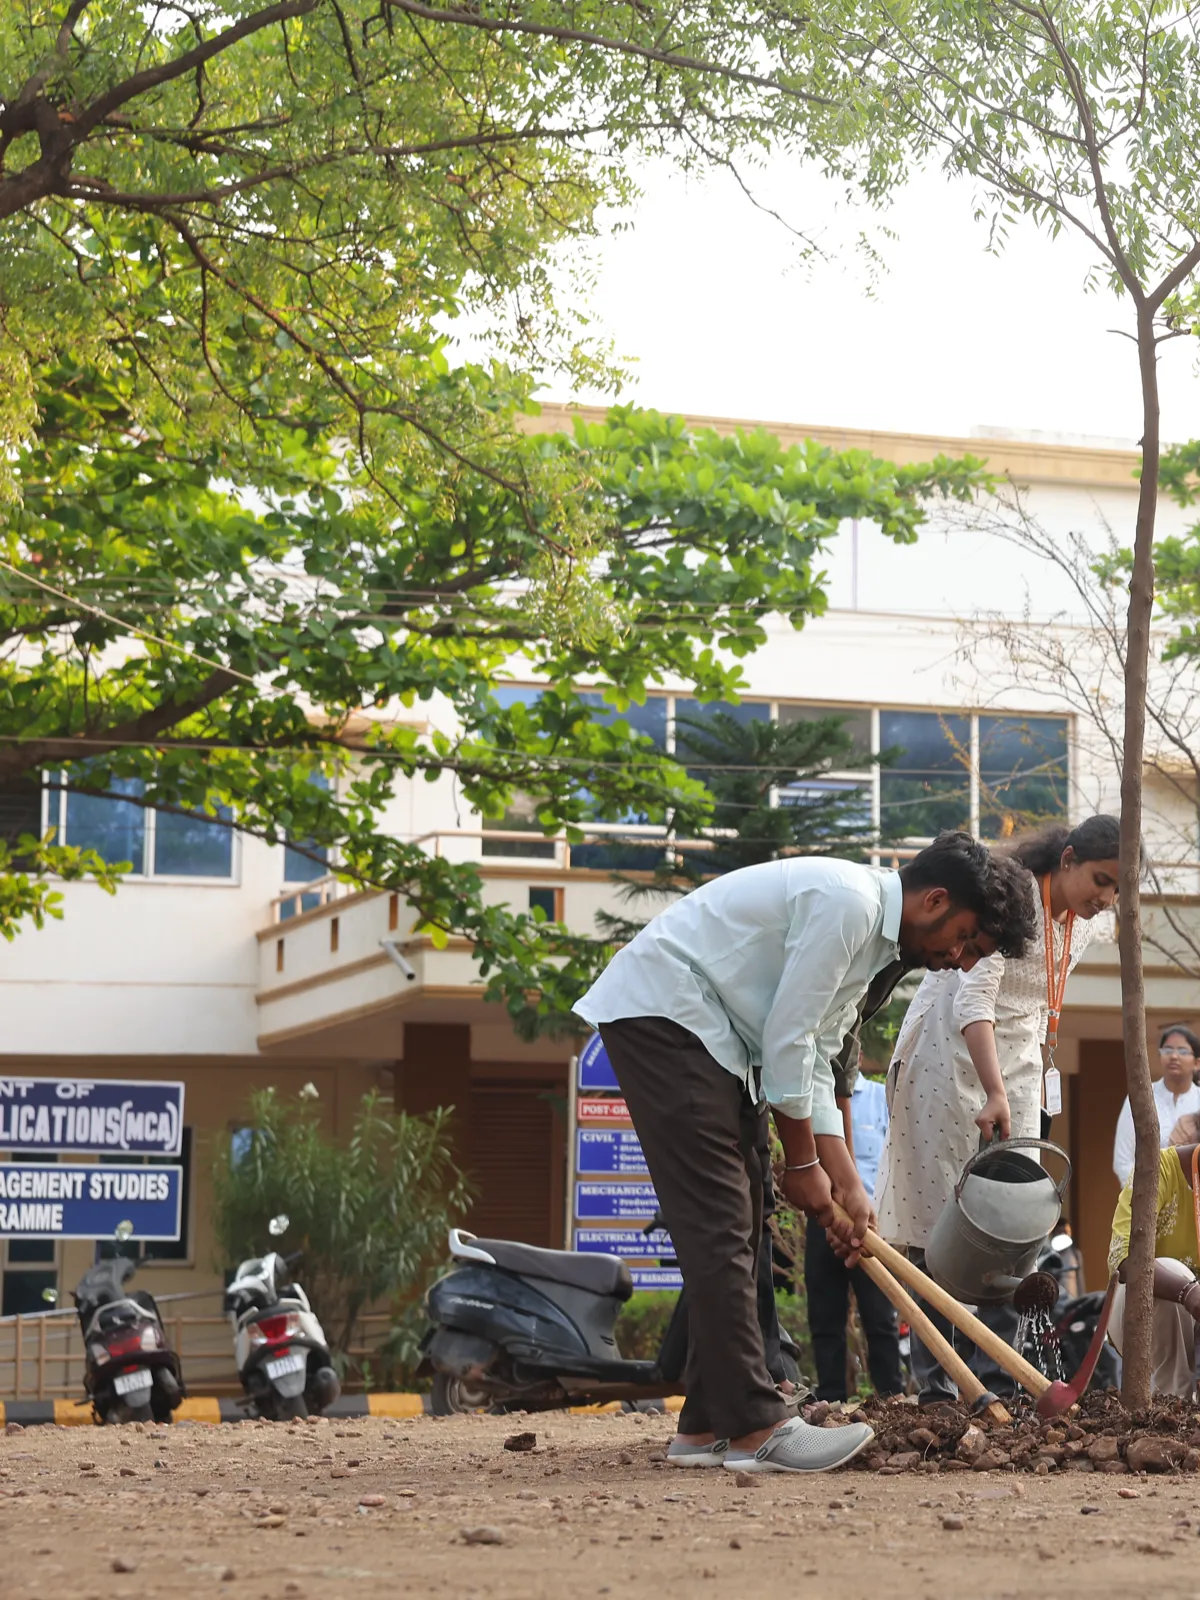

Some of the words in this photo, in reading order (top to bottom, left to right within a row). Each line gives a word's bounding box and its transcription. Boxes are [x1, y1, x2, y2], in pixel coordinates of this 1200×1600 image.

[56, 1082, 95, 1099] OF
[582, 1133, 615, 1142] CIVIL
[0, 1171, 86, 1199] AGEMENT
[89, 1173, 169, 1200] STUDIES
[580, 1233, 637, 1242] ELECTRICAL
